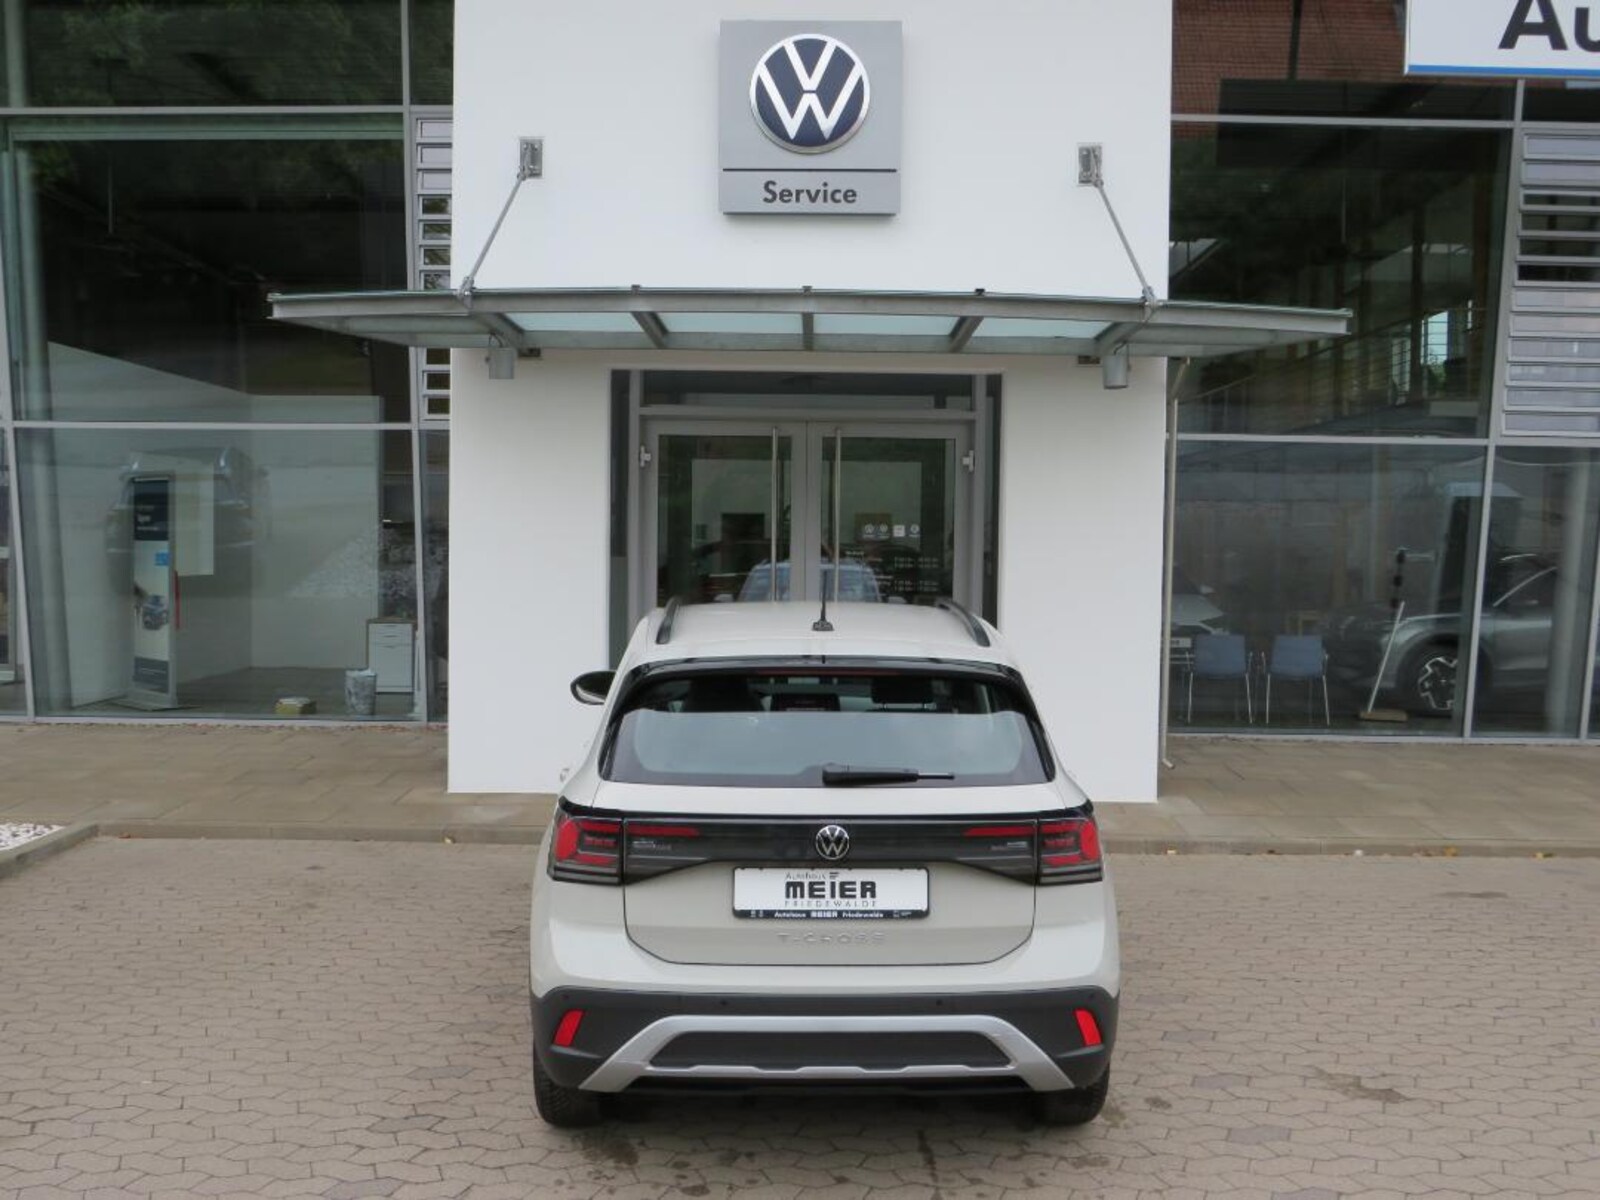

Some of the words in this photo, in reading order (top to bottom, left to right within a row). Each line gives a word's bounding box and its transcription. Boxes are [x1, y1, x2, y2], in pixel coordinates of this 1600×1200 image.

[752, 35, 869, 150] VW
[763, 180, 857, 204] Service
[785, 881, 877, 899] MEIER
[785, 900, 877, 908] FRIEDEWALDE
